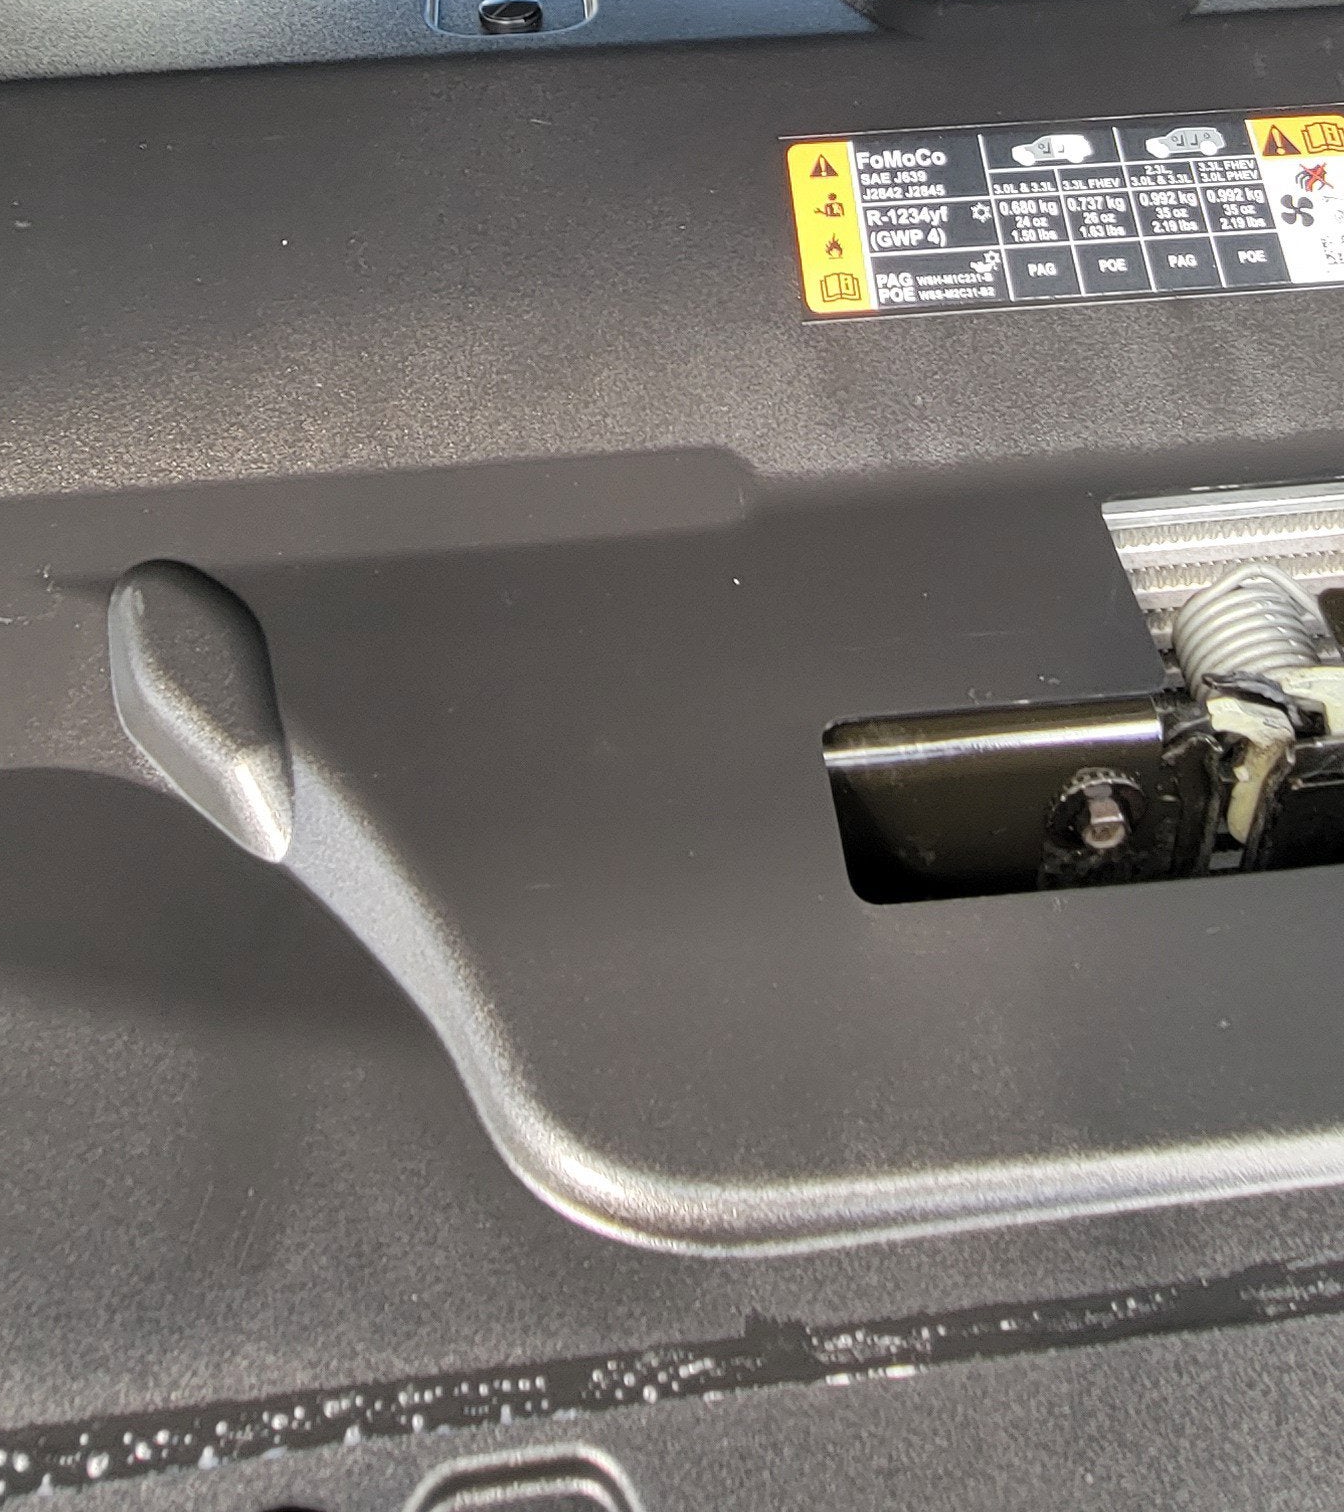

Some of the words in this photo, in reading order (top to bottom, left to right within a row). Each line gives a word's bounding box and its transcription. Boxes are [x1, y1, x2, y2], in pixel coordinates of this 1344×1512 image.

[856, 148, 947, 169] FoMoCo
[1223, 159, 1256, 171] FHEV
[860, 172, 892, 186] SAE
[894, 170, 928, 184] J639
[1130, 175, 1155, 187] 3.0L
[1157, 174, 1167, 185] &
[1168, 173, 1193, 184] 3.3L
[1200, 171, 1226, 183] 3.0L
[1226, 170, 1258, 181] PHEV
[993, 184, 1018, 195] 3.0L
[1020, 182, 1030, 193] &
[1031, 181, 1056, 193] 3.3L
[1062, 179, 1088, 191] 3.3L
[1088, 177, 1121, 189] FHEV
[862, 186, 903, 201] J2842
[905, 183, 946, 199] J2845
[1139, 191, 1177, 207] 0.992
[1177, 190, 1198, 207] kg
[1206, 188, 1245, 204] 0.992
[1244, 187, 1265, 204] kg
[999, 199, 1037, 216] 0.680
[1038, 199, 1058, 216] kg
[1067, 196, 1104, 212] 0.737
[1105, 195, 1126, 212] kg
[1222, 204, 1239, 216] 35
[1239, 204, 1257, 215] oz
[866, 205, 948, 227] R-1234yf
[1083, 212, 1098, 224] 26
[1100, 213, 1116, 224] oz
[1155, 207, 1172, 219] 35
[1172, 208, 1189, 218] oz
[1015, 216, 1031, 228] 24
[1032, 217, 1049, 228] oz
[1152, 220, 1177, 233] 2.19
[1178, 219, 1199, 231] lbs
[1219, 216, 1246, 230] 2.19
[1245, 216, 1266, 228] lbs
[1011, 229, 1037, 242] 1.50
[1037, 228, 1058, 241] lbs
[1079, 225, 1105, 238] 1.63
[1105, 224, 1126, 237] lbs
[870, 229, 924, 252] (GWP
[927, 227, 947, 248] 4)
[1167, 254, 1198, 268] PAG
[1237, 250, 1267, 264] POE
[1027, 262, 1057, 277] PAG
[1098, 258, 1128, 273] POE
[876, 272, 914, 288] PAG
[878, 287, 916, 304] POE
